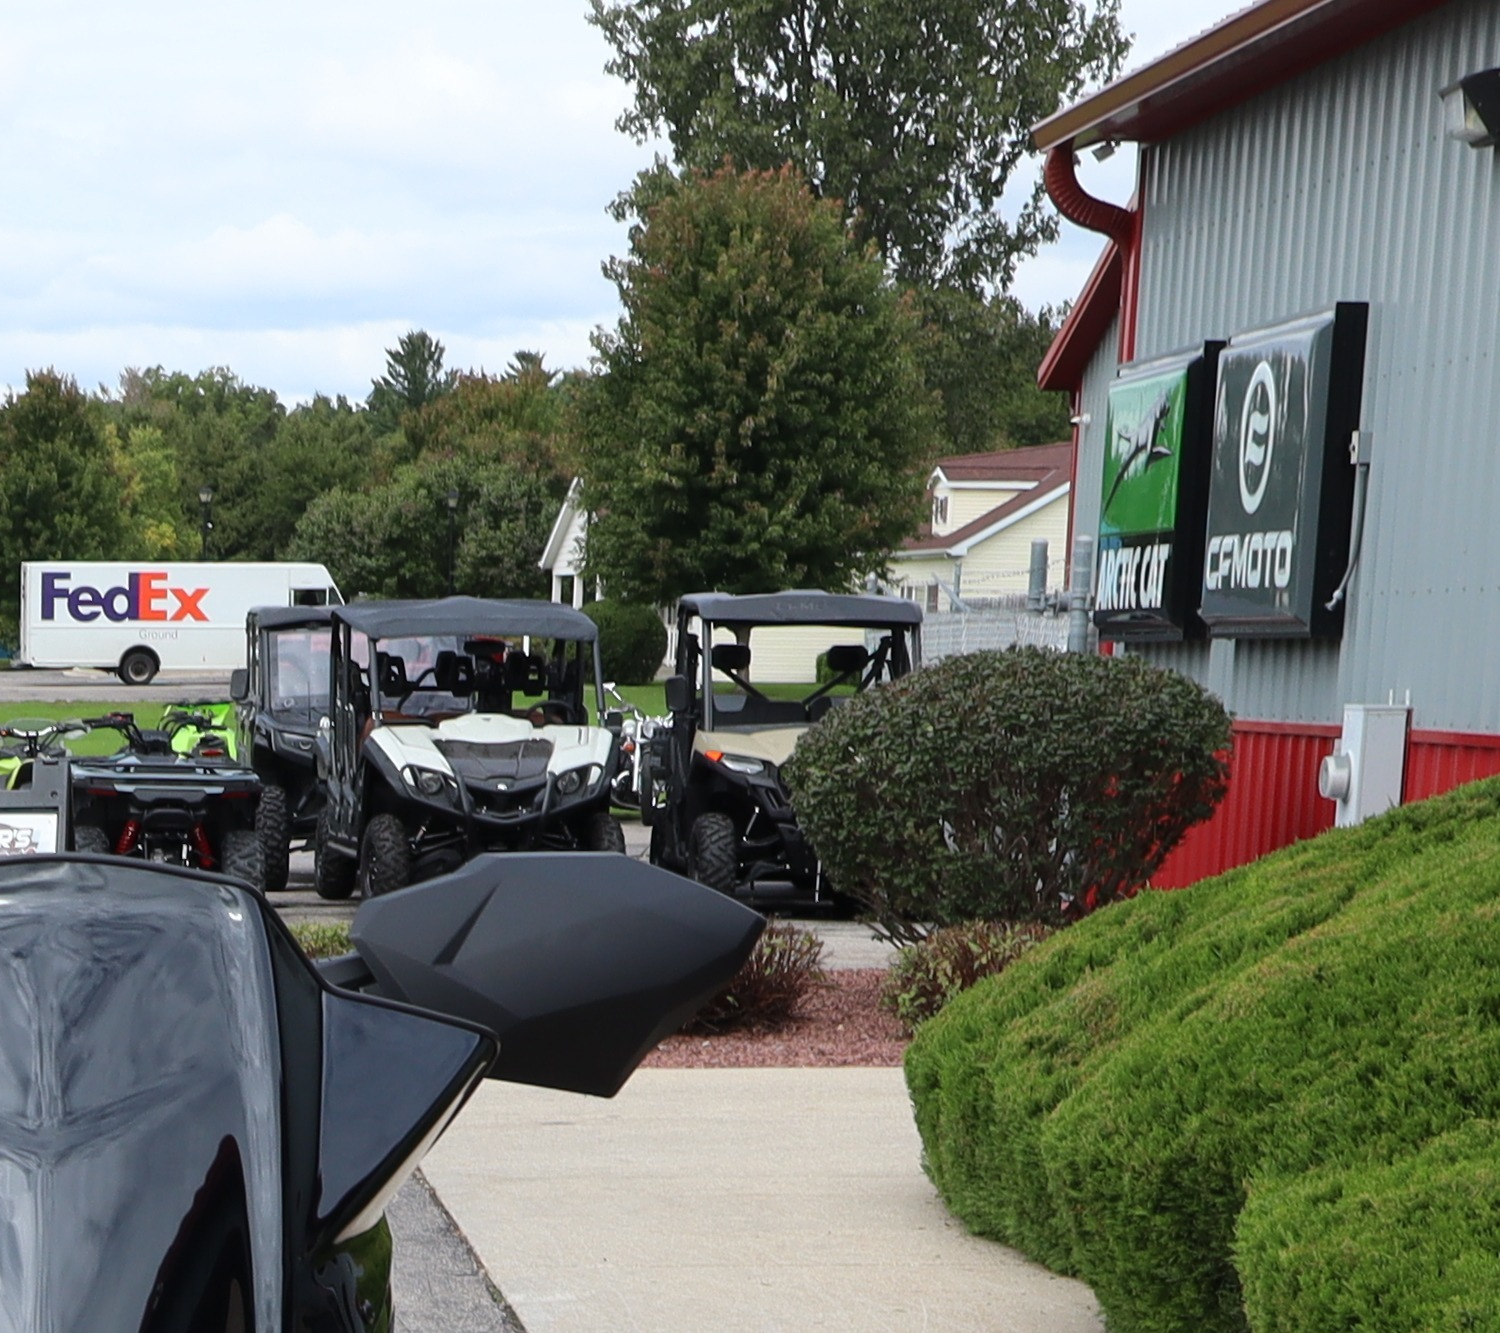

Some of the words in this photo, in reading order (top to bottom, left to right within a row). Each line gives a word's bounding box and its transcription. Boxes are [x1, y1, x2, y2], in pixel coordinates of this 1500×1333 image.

[1095, 545, 1141, 611] ARCTIC
[1139, 543, 1170, 609] CAT
[1205, 530, 1293, 590] CFMOTO
[41, 571, 210, 623] FedEx
[138, 629, 178, 641] Ground
